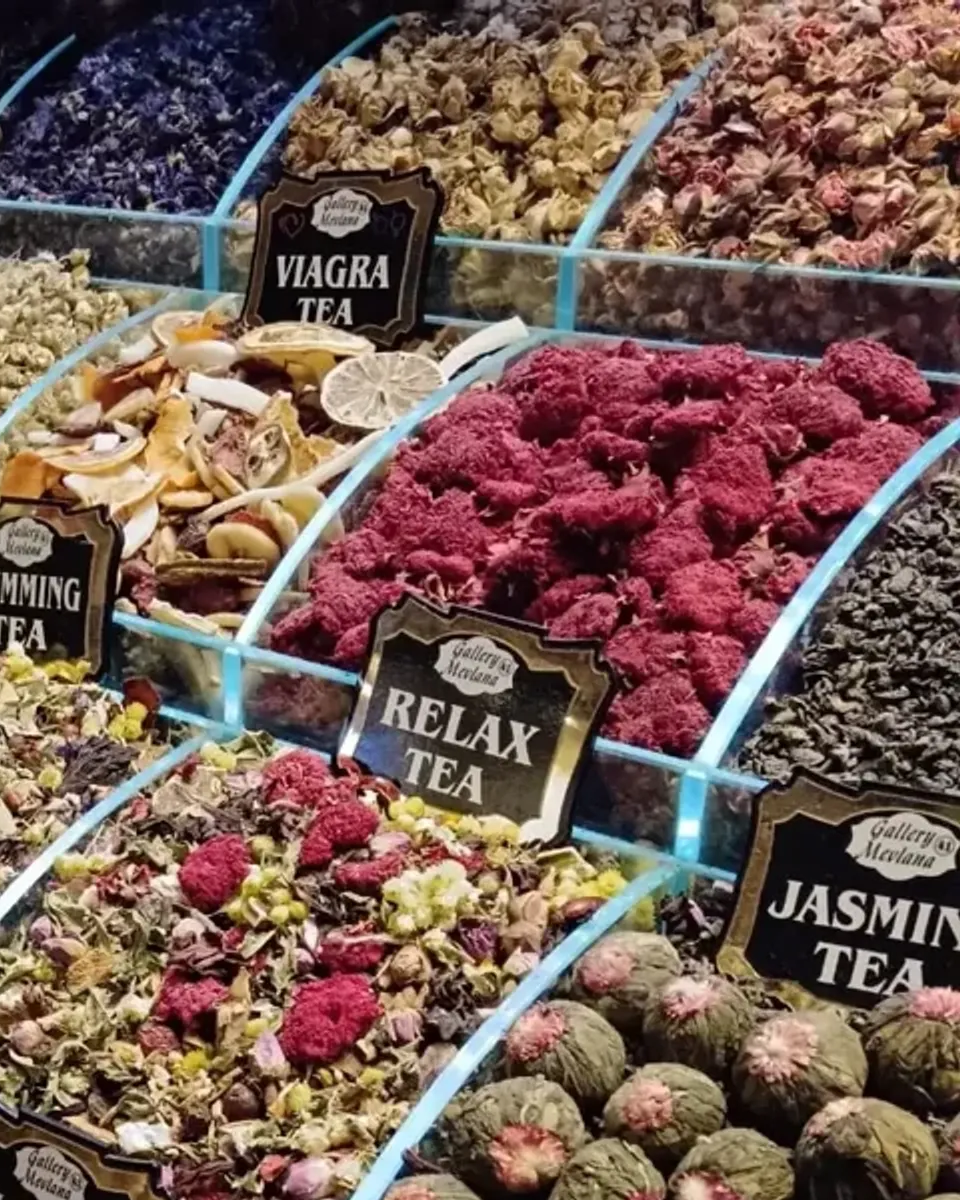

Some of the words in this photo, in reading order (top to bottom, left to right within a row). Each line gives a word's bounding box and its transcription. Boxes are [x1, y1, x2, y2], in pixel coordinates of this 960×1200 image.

[276, 254, 390, 289] VIAGRA
[296, 298, 354, 325] TEA
[452, 640, 500, 669] Gallery
[379, 687, 540, 766] RELAX
[404, 748, 484, 805] TEA
[870, 819, 937, 849] Gallery
[854, 840, 936, 870] Mevlana
[813, 941, 924, 997] TEA
[28, 1149, 71, 1182] Gallery
